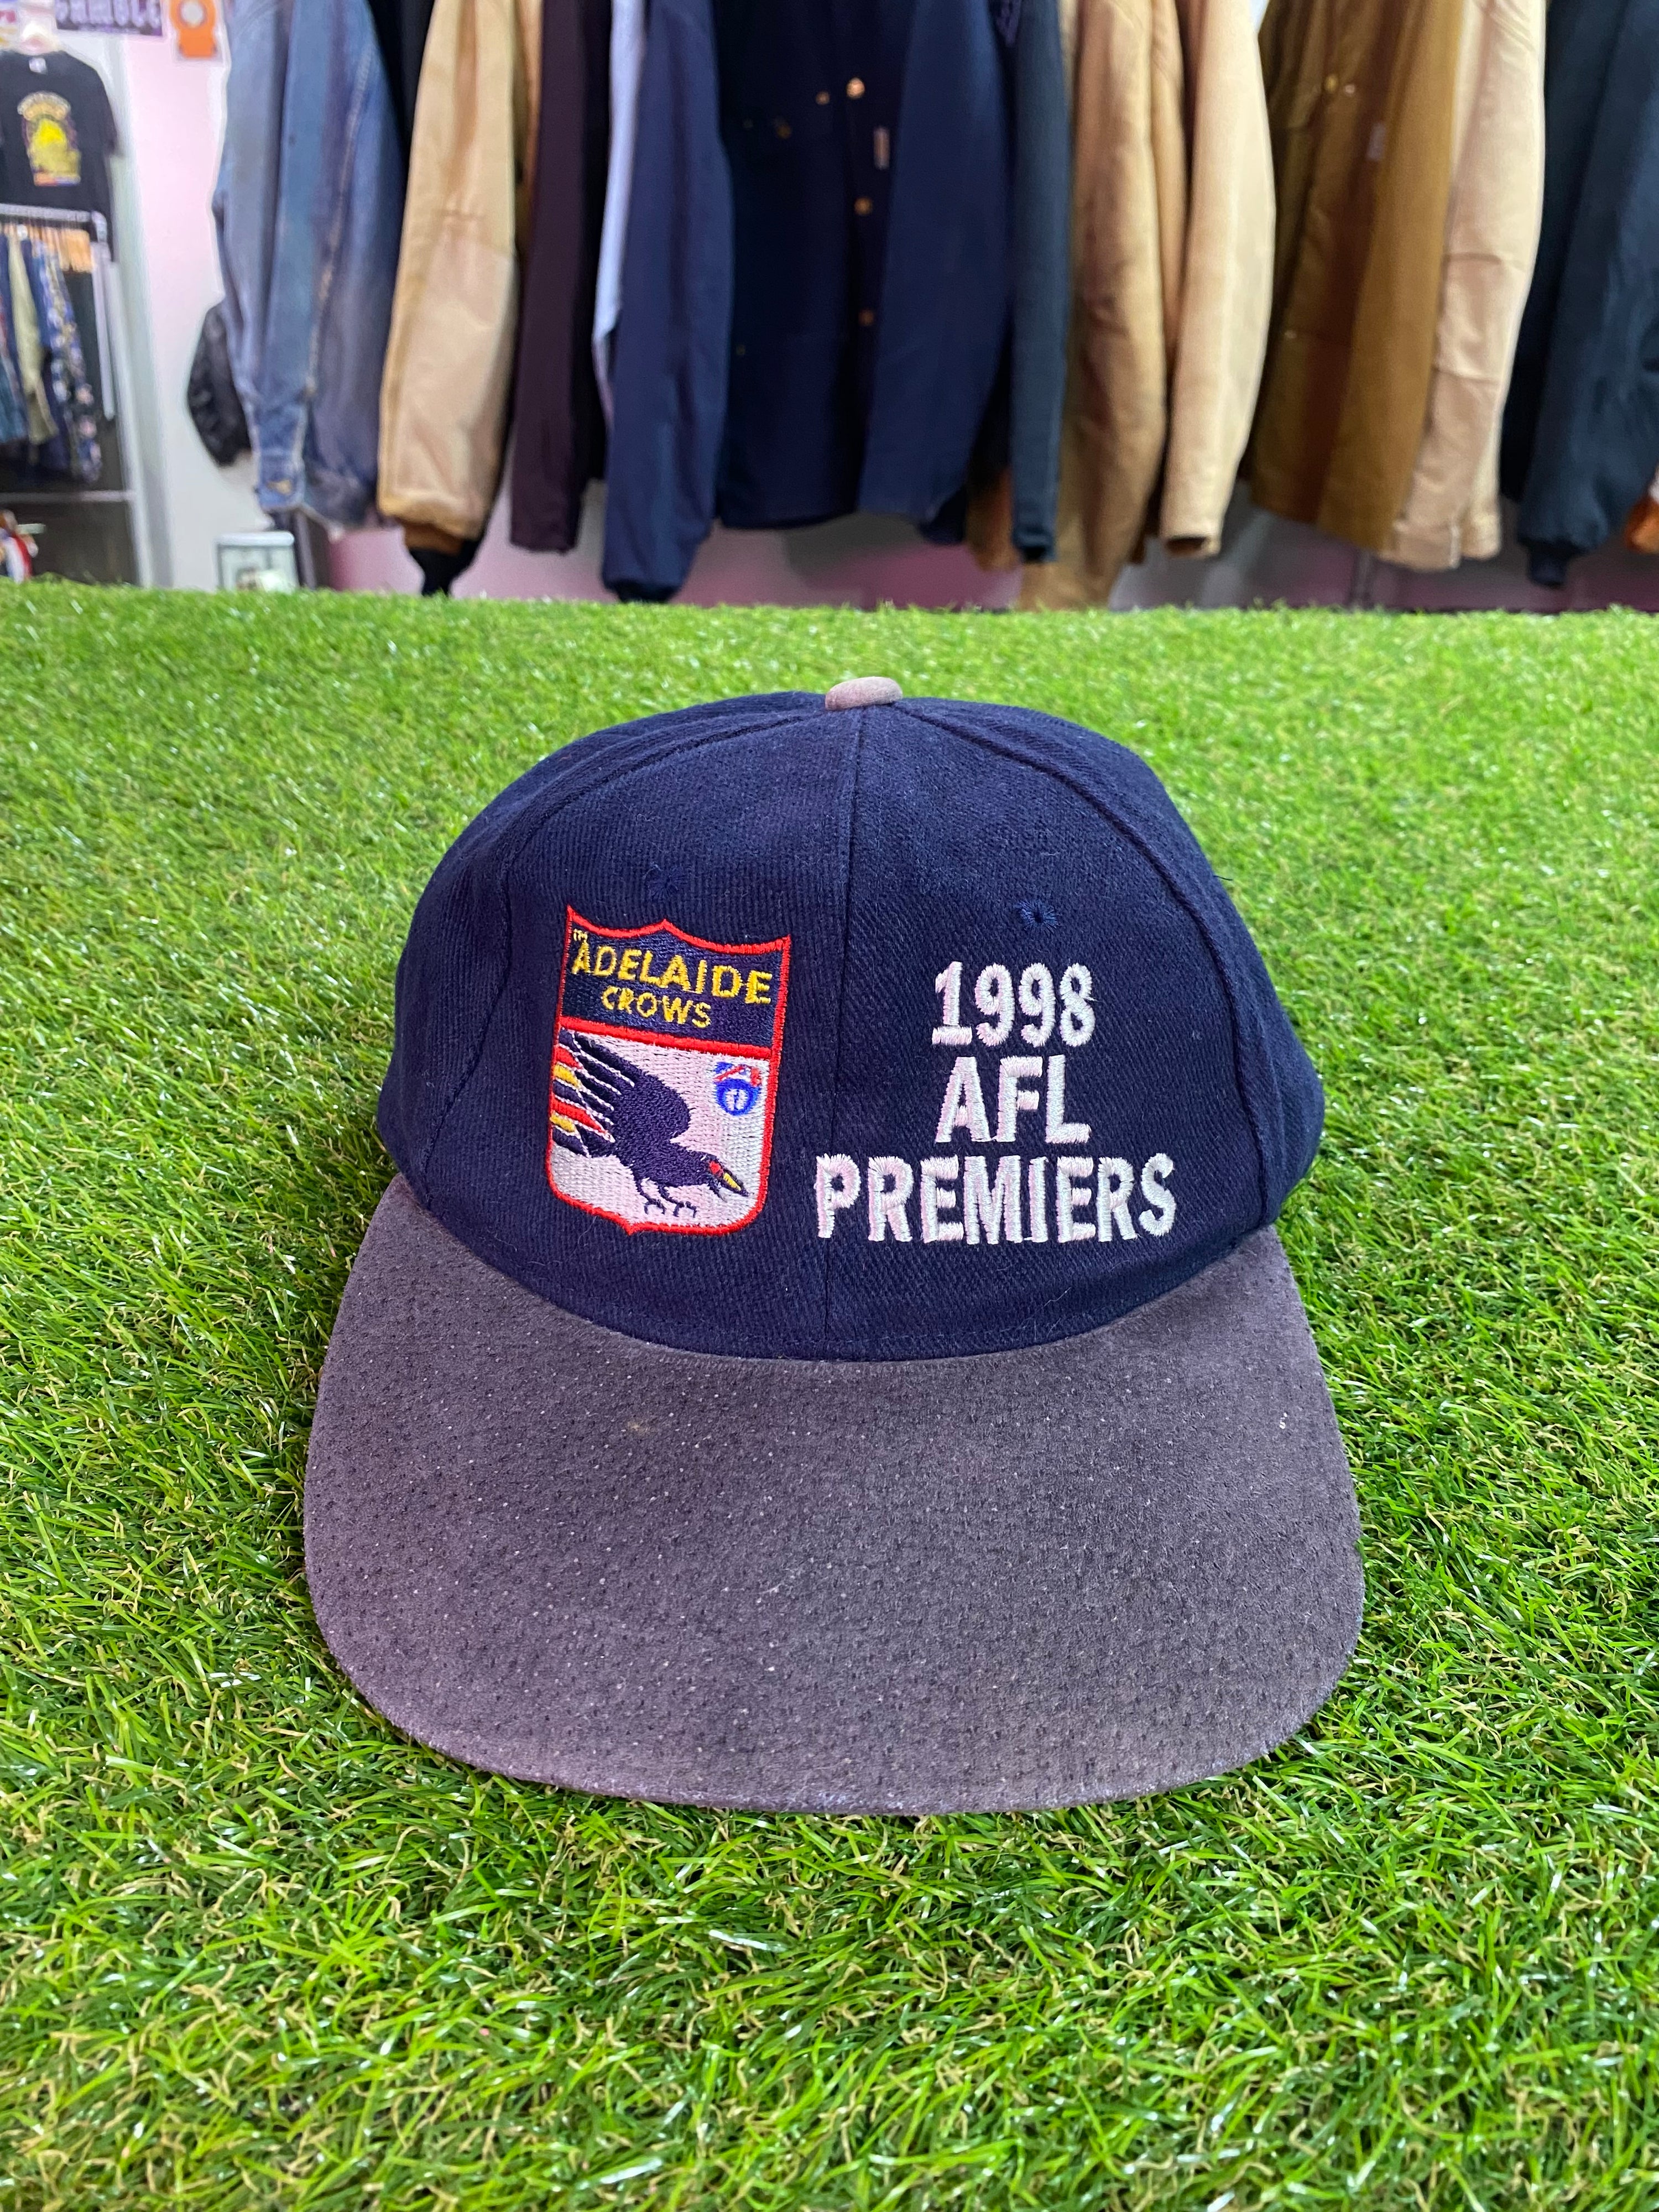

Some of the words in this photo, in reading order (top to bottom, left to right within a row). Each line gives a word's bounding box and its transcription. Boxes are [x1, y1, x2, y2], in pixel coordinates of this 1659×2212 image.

[571, 940, 773, 1005] ADELAIDE
[601, 986, 712, 1028] CROWS
[932, 961, 1097, 1048] 1998
[935, 1054, 1092, 1144] AFL
[813, 1152, 1177, 1244] PREMIERS
